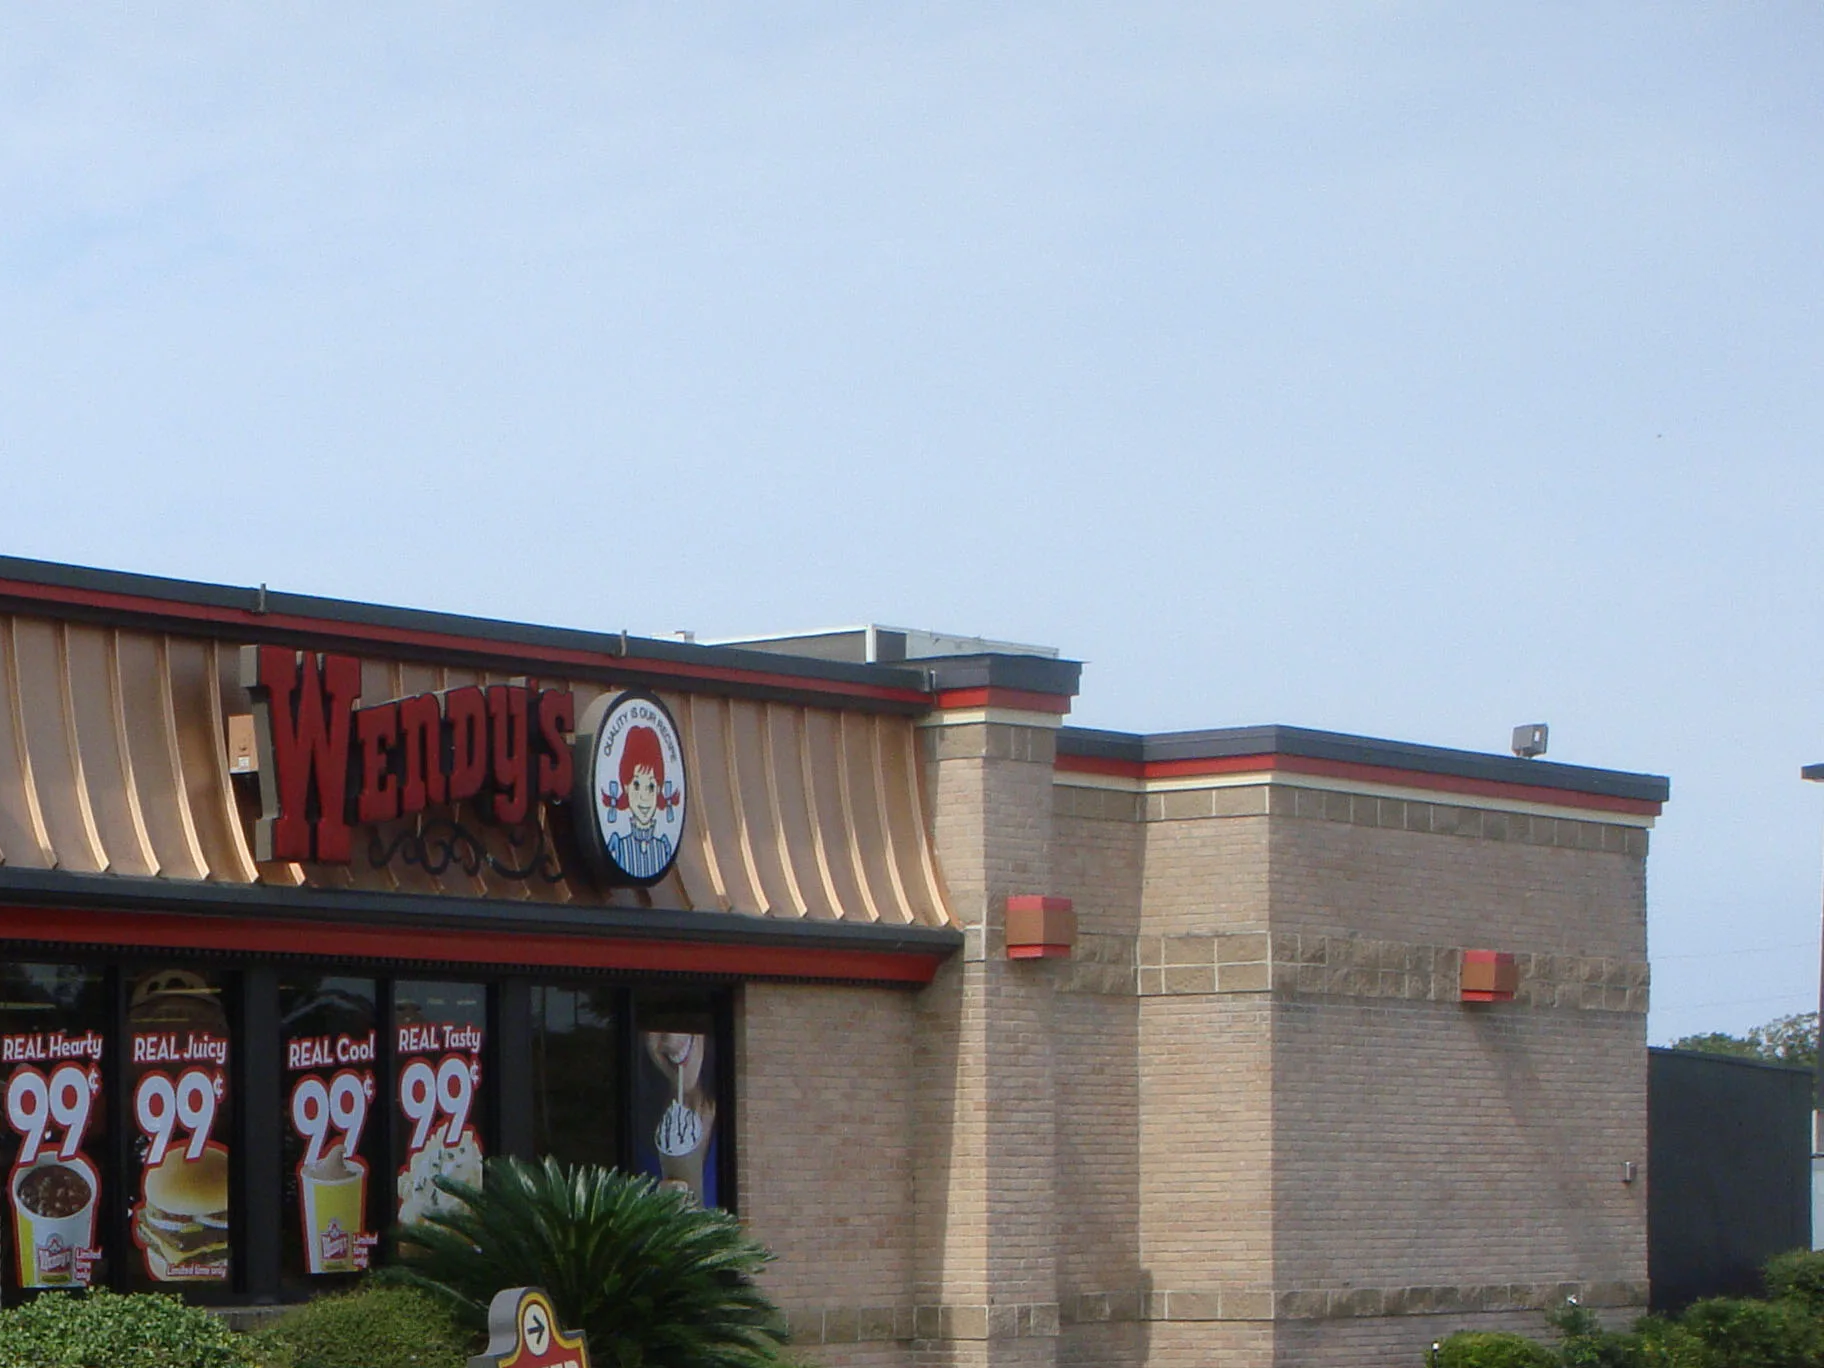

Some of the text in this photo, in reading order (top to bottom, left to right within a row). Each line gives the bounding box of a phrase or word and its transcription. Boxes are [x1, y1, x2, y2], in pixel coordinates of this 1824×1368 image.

[603, 711, 629, 758] QUALITY
[2, 1033, 103, 1061] REAL Hearty
[133, 1035, 226, 1063] REAL Juicy
[288, 1035, 375, 1068] REAL Cool
[398, 1025, 481, 1053] REAL Tasty
